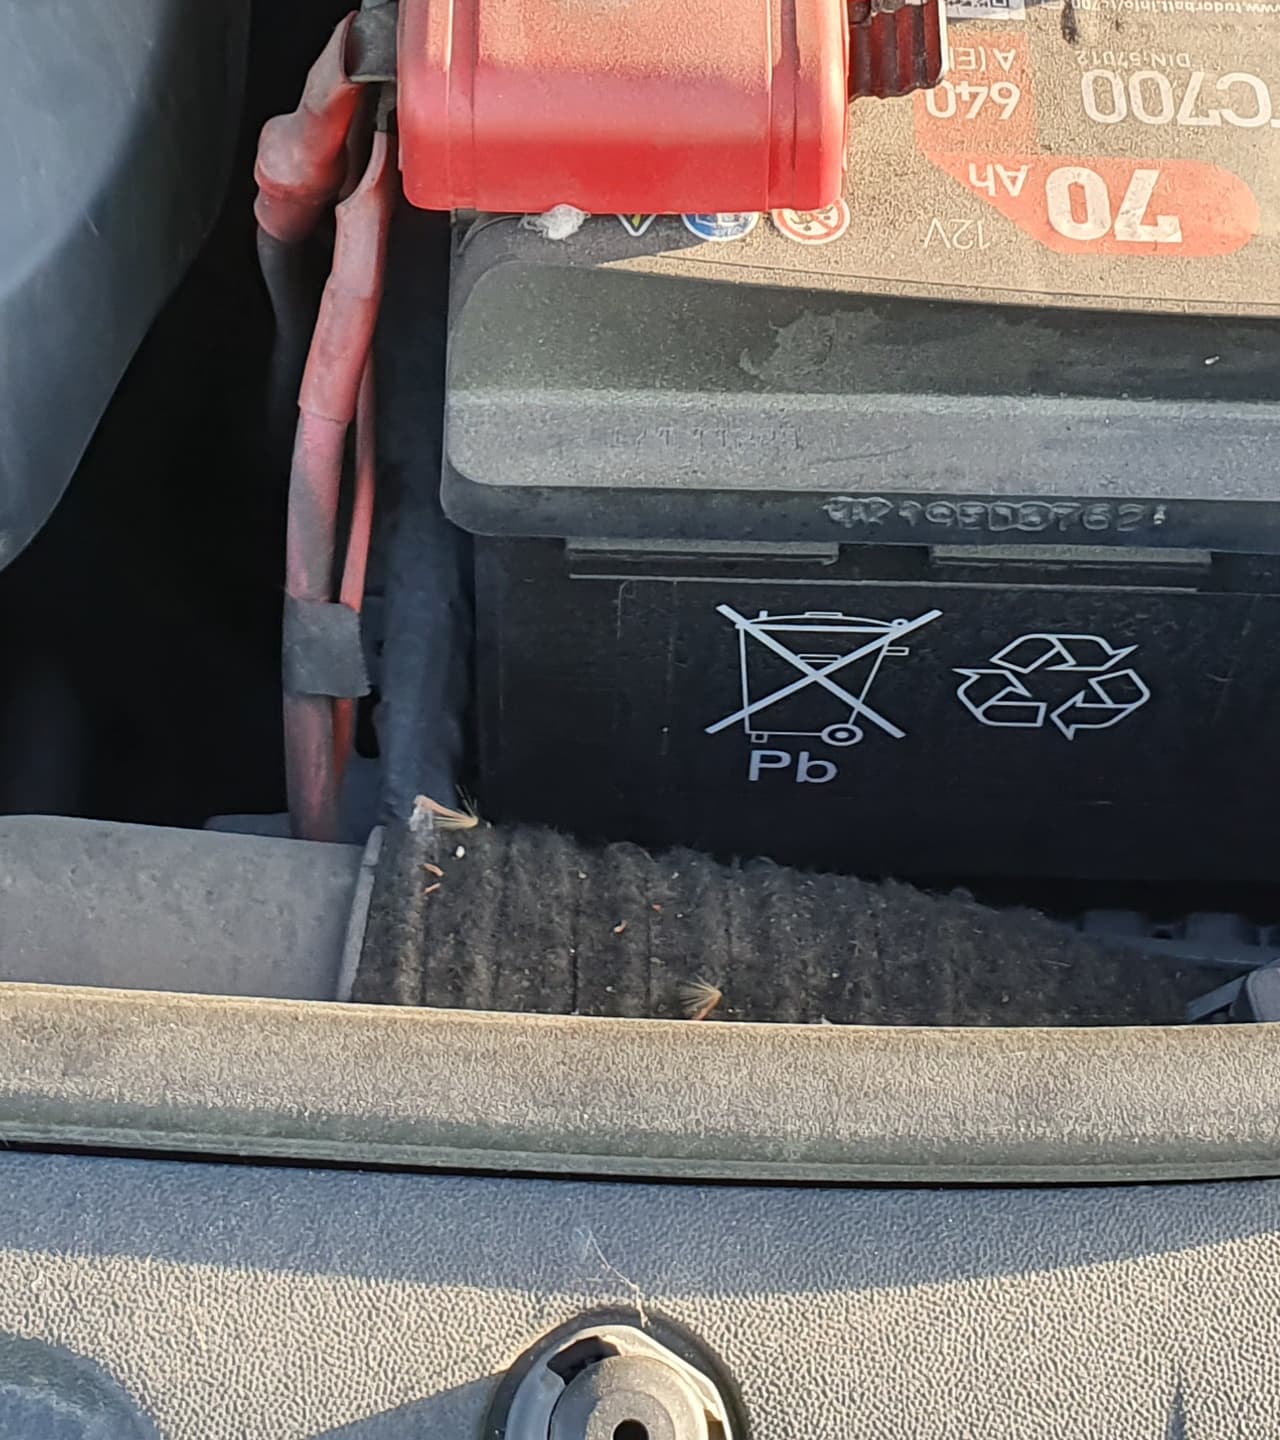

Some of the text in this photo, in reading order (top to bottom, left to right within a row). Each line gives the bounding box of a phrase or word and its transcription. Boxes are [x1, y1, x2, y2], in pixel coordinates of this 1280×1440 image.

[992, 48, 1017, 73] A
[925, 80, 1021, 120] 640
[967, 162, 1183, 243] 70 Ah
[921, 218, 991, 250] 12V
[748, 749, 839, 784] Pb
